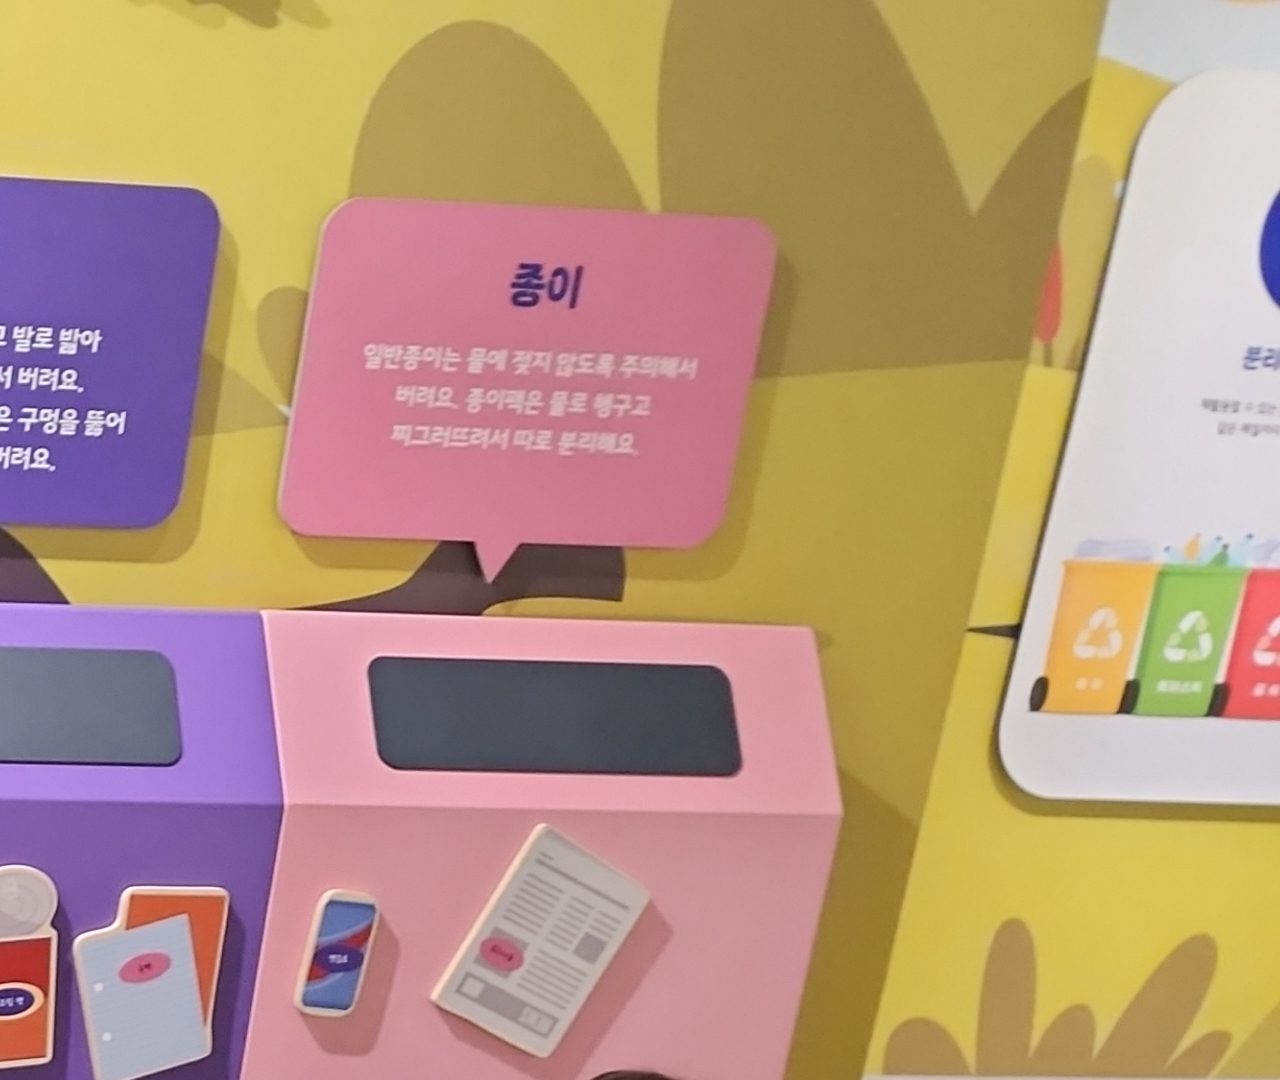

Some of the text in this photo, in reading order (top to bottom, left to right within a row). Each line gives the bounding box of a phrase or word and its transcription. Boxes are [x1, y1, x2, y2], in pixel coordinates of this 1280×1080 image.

[509, 262, 584, 310] 종이
[12, 325, 54, 353] 발로
[363, 343, 462, 372] 일반종이는
[17, 367, 84, 393] 버려요.
[17, 407, 80, 436] 구멍을
[83, 409, 127, 437] 뚫어
[512, 429, 553, 451] 따로
